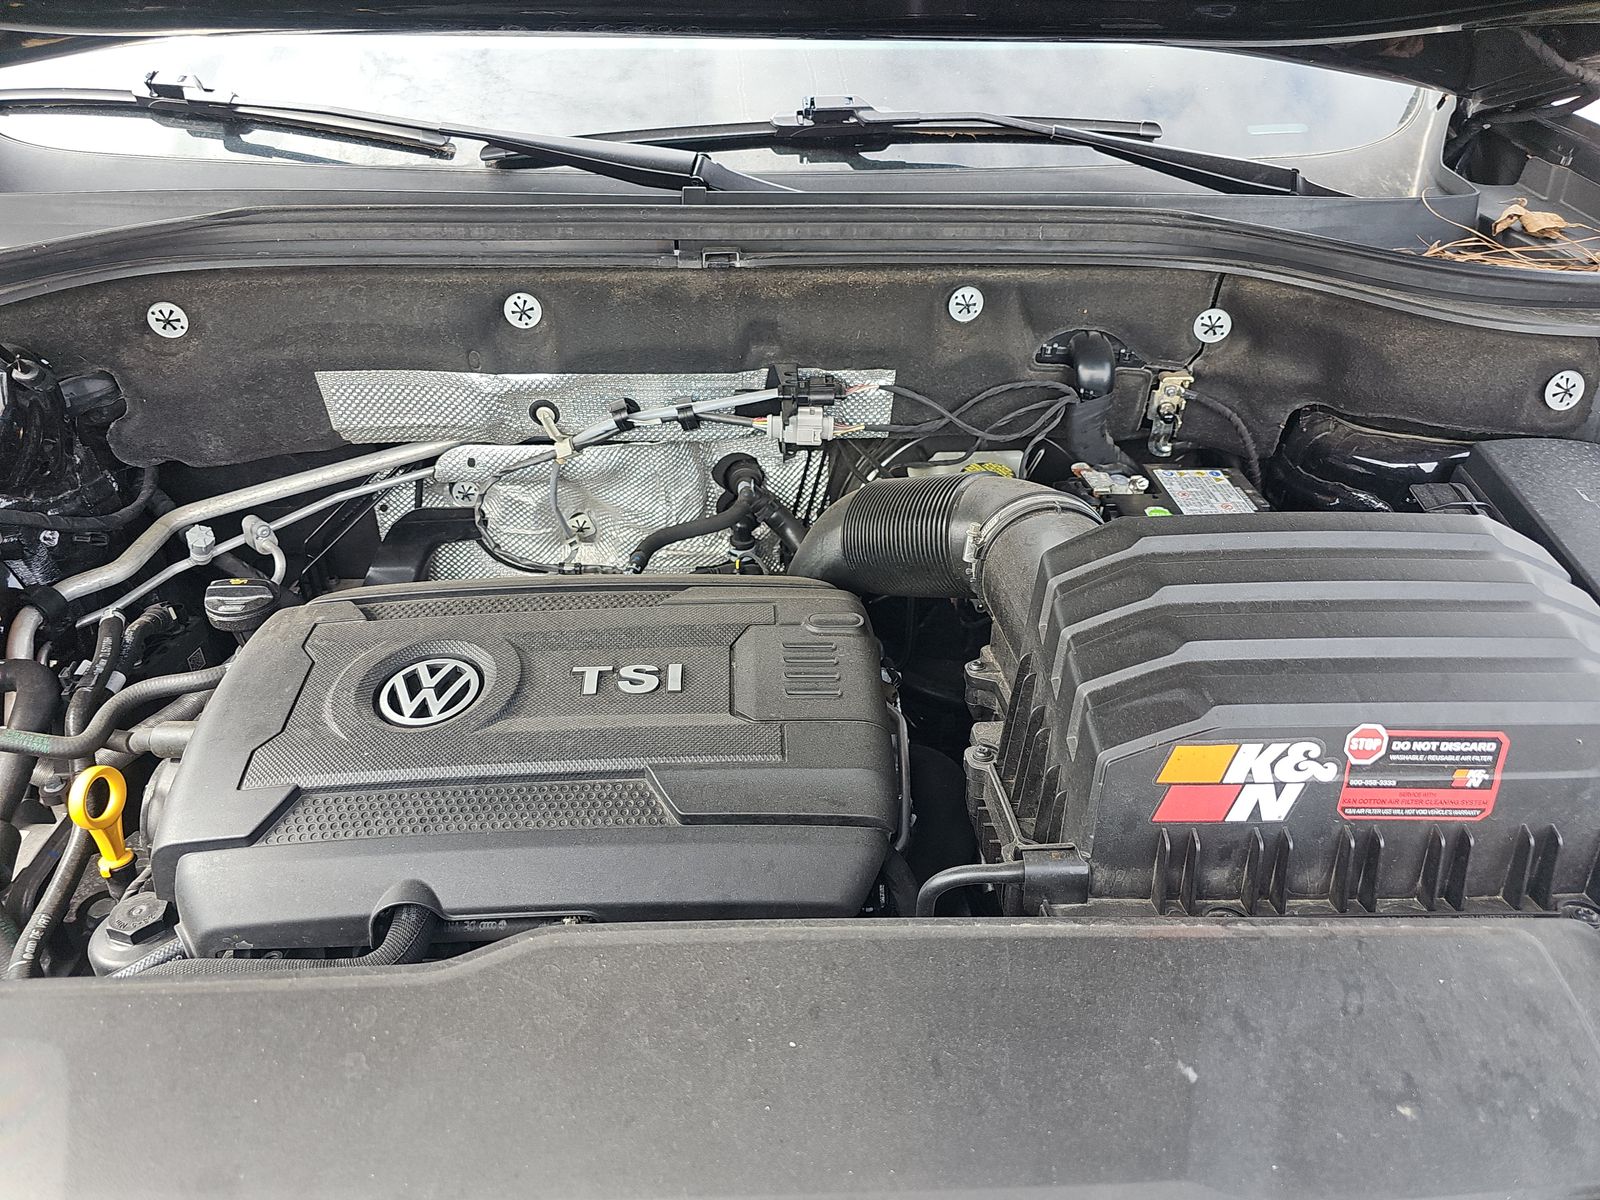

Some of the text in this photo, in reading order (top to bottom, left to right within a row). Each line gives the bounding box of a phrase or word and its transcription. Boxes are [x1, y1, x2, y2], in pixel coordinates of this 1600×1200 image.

[572, 663, 684, 696] TSI
[1350, 737, 1382, 751] STOP
[1391, 741, 1497, 752] DO NOT DISCARD
